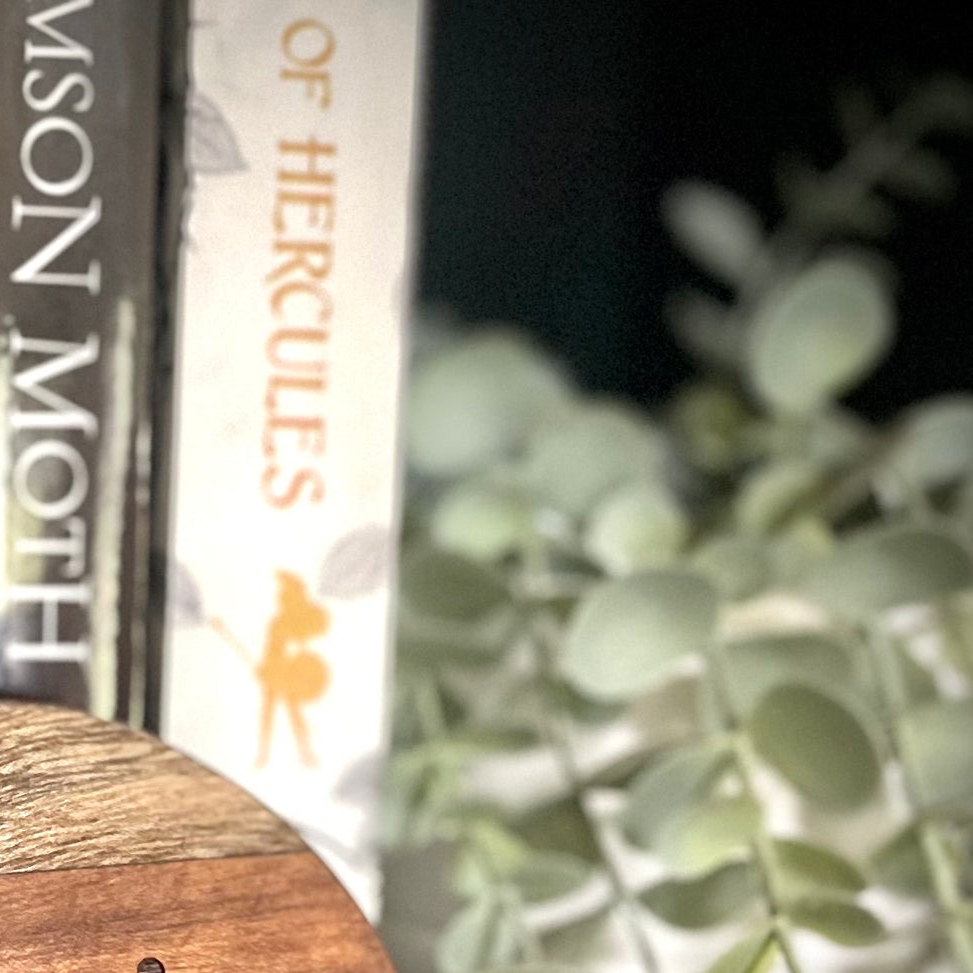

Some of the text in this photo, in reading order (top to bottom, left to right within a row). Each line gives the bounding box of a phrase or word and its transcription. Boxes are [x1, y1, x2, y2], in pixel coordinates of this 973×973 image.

[5, 0, 102, 663] MSON MOTH
[258, 18, 338, 511] OF HERCULES
